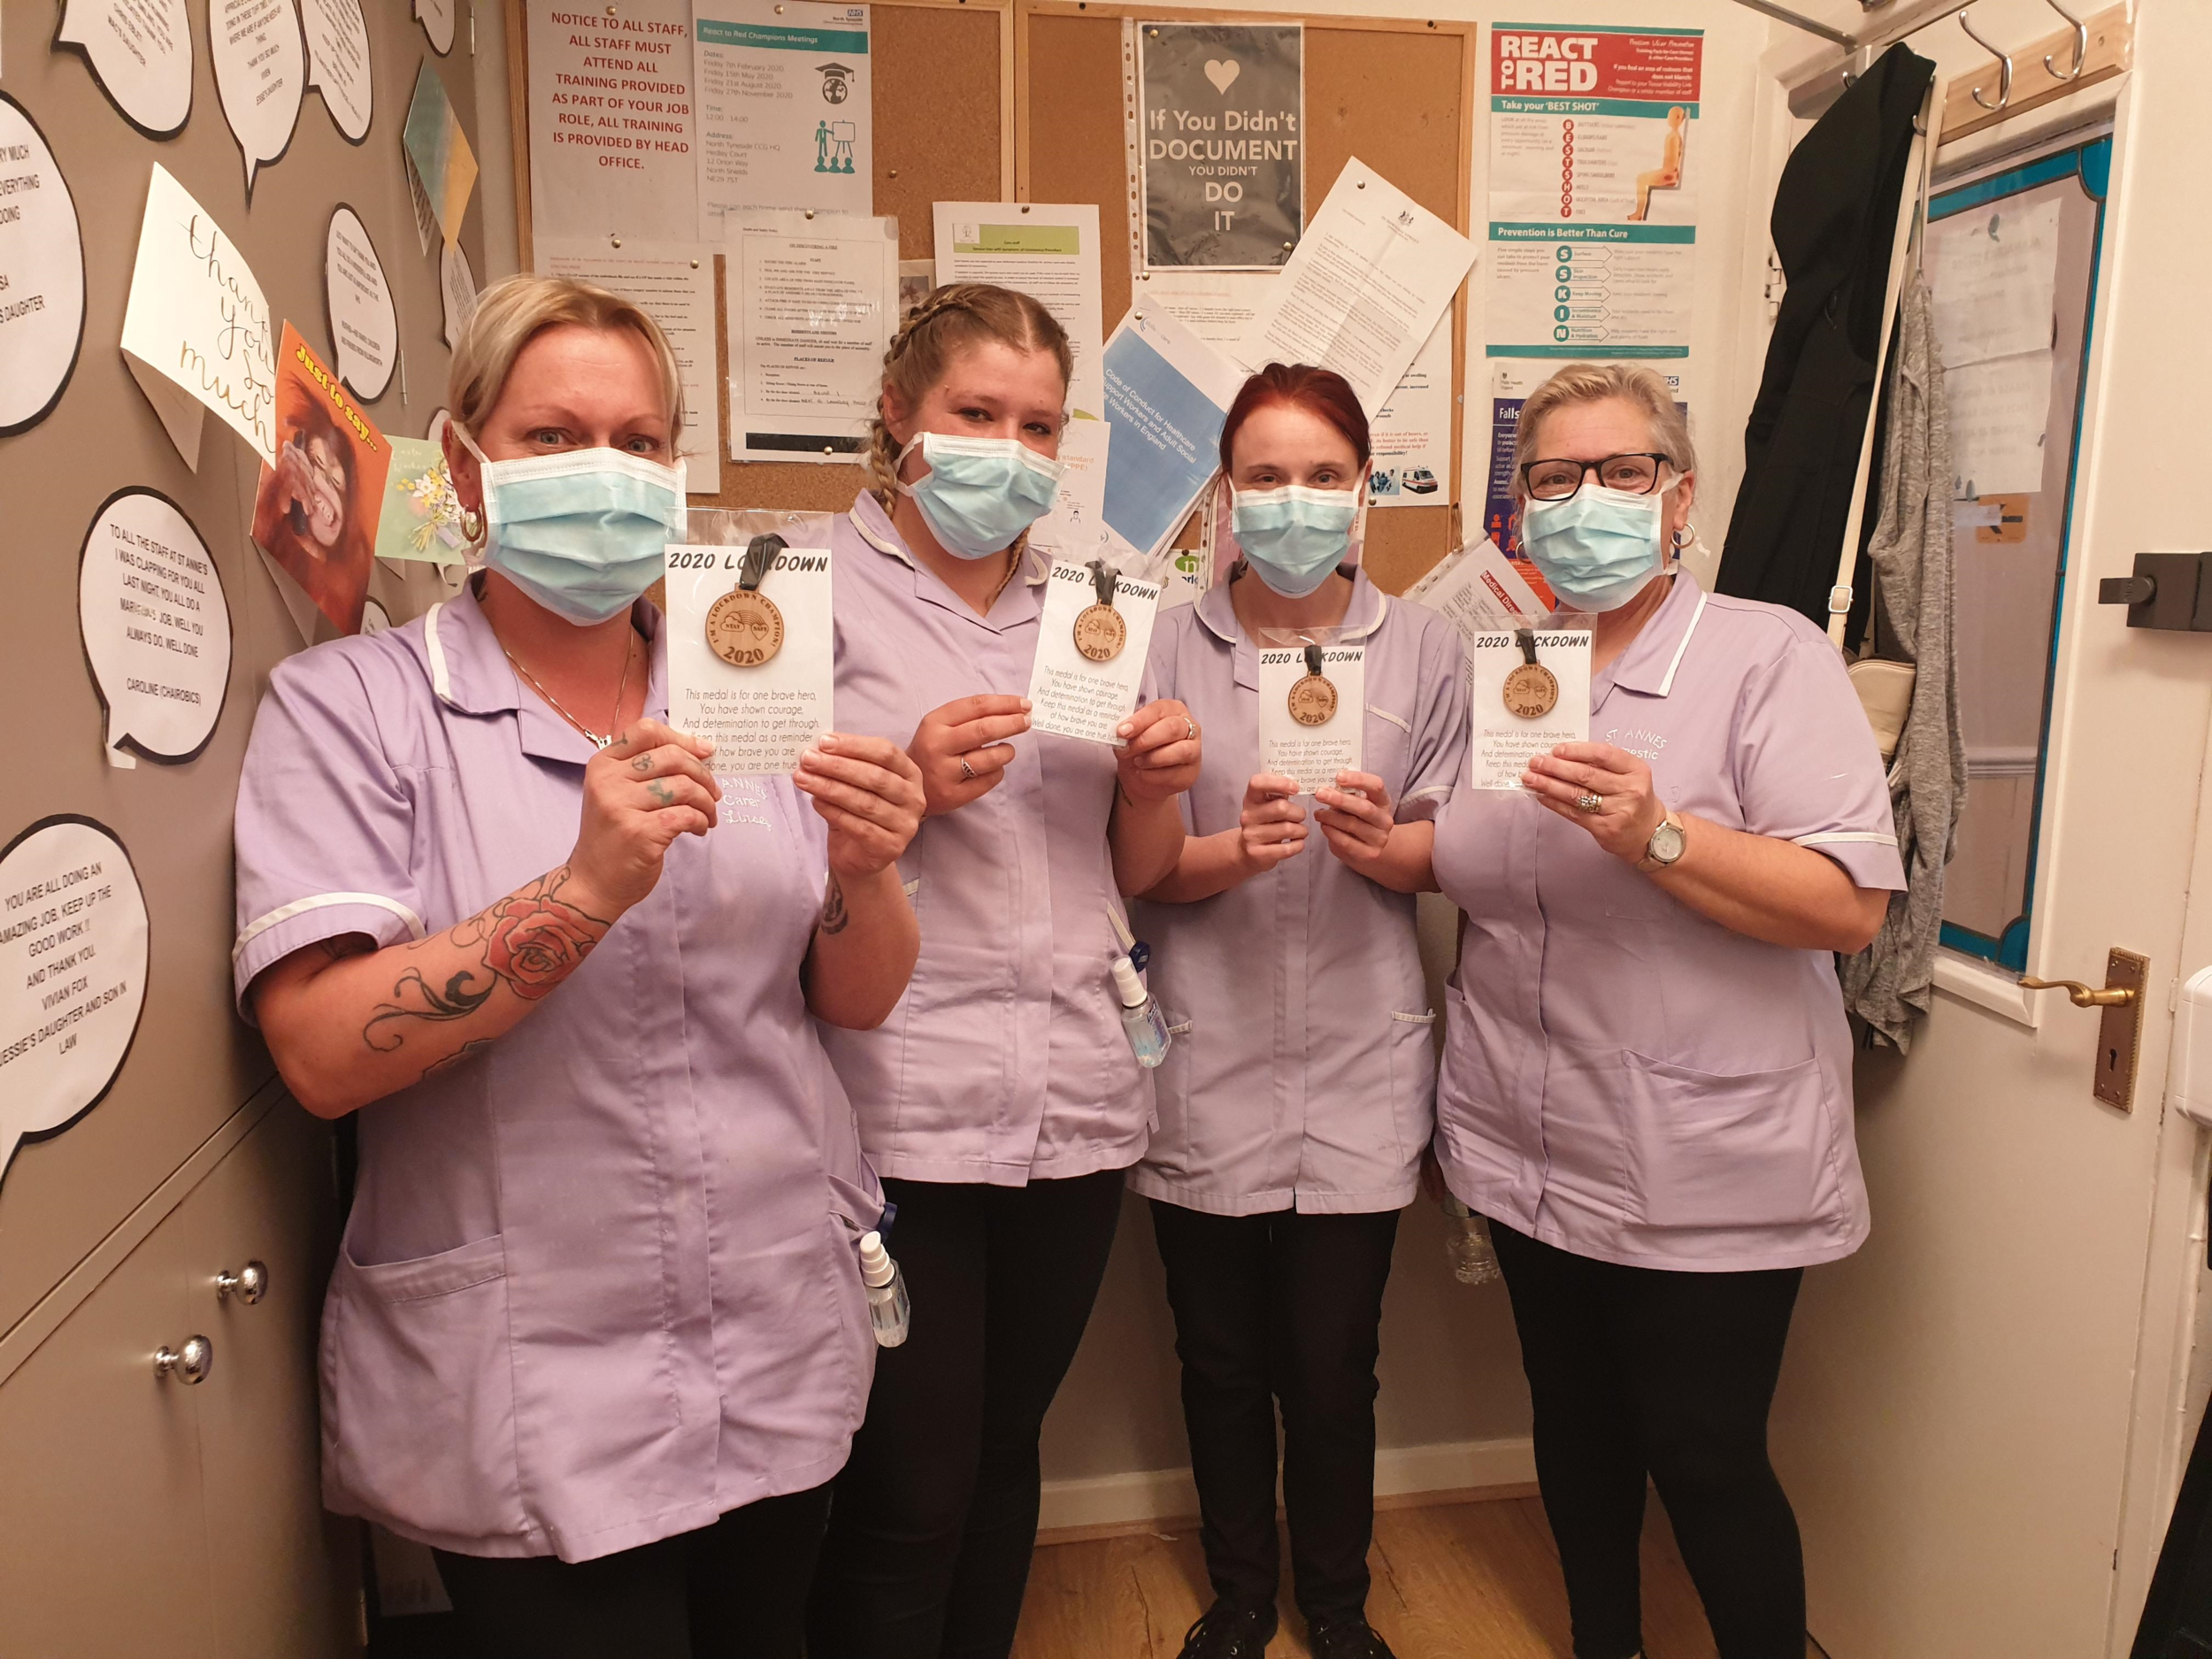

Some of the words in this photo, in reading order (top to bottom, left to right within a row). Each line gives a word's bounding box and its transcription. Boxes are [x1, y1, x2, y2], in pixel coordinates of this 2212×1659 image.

[551, 12, 597, 27] NOTICE
[602, 18, 618, 29] TO
[623, 20, 643, 32] ALL
[648, 22, 687, 38] STAFF,
[703, 27, 723, 36] React
[749, 33, 786, 42] Champions
[787, 35, 818, 43] Meetings
[570, 35, 590, 47] ALL
[595, 37, 631, 50] STAFF
[635, 41, 671, 54] MUST
[1501, 35, 1598, 60] REACT
[584, 57, 633, 70] ATTEND
[637, 62, 657, 73] ALL
[1501, 59, 1514, 89] TO
[1517, 60, 1598, 91] RED
[557, 73, 618, 88] TRAINING
[622, 80, 685, 95] PROVIDED
[552, 93, 567, 104] AS
[572, 95, 603, 106] PART
[608, 98, 624, 109] OF
[628, 100, 663, 112] YOUR
[666, 103, 689, 114] JOB
[1502, 100, 1522, 109] Take
[1524, 103, 1544, 111] your
[559, 113, 594, 127] ROLE,
[598, 117, 618, 127] ALL
[623, 119, 682, 134] TRAINING
[1150, 109, 1166, 130] If
[1172, 111, 1216, 131] You
[1225, 110, 1295, 131] Didn't
[553, 132, 564, 142] IS
[568, 134, 632, 149] PROVIDED
[636, 139, 650, 150] BY
[656, 140, 688, 153] HEAD
[1150, 139, 1297, 160] DOCUMENT
[599, 156, 644, 169] OFFICE.
[1188, 166, 1214, 176] YOU
[1218, 166, 1258, 176] DIDN'T
[1206, 181, 1242, 202] DO
[1215, 211, 1235, 231] IT
[1498, 227, 1545, 237] Prevention
[1586, 229, 1607, 238] Than
[1609, 229, 1628, 238] Cure
[5, 296, 45, 321] DAUGHTER
[296, 343, 328, 390] Just
[329, 382, 344, 409] to
[180, 341, 275, 453] much
[1106, 369, 1122, 386] Code
[1129, 390, 1156, 415] Conduct
[1154, 412, 1164, 422] for
[1164, 420, 1195, 451] Healthcare
[1110, 397, 1134, 423] Workers
[1141, 426, 1167, 450] England
[1124, 397, 1148, 422] Workers
[1148, 421, 1162, 434] and
[1161, 431, 1178, 448] Adult
[1177, 444, 1197, 464] Social
[111, 524, 120, 539] TO
[122, 529, 135, 545] ALL
[136, 534, 150, 550] THE
[150, 541, 169, 558] STAFF
[170, 550, 176, 562] AT
[178, 553, 185, 565] ST
[115, 548, 118, 560] I
[119, 549, 134, 566] WAS
[136, 557, 166, 579] CLAPPING
[168, 570, 179, 584] FOR
[180, 575, 192, 589] YOU
[194, 580, 204, 594] ALL
[669, 553, 716, 569] 2020
[1052, 566, 1085, 583] 2020
[1481, 572, 1504, 598] Medical
[712, 593, 758, 618] LOCKDOWN
[760, 598, 780, 648] CHAMPION!
[127, 626, 151, 644] ALWAYS
[165, 638, 182, 653] WELL
[183, 642, 198, 657] DONE
[1084, 644, 1110, 659] 2020
[1477, 637, 1509, 648] 2020
[723, 646, 764, 664] 2020
[1261, 653, 1291, 664] 2020
[127, 678, 158, 695] CAROLINE
[686, 688, 700, 700] This
[703, 689, 728, 700] medal
[731, 689, 736, 700] is
[739, 690, 749, 700] for
[753, 692, 769, 701] one
[772, 690, 795, 701] brave
[797, 690, 817, 701] hero,
[700, 703, 716, 714] You
[718, 704, 739, 714] have
[741, 703, 765, 714] shown
[1300, 712, 1325, 723] 2020
[1515, 703, 1544, 716] 2020
[1606, 729, 1617, 741] ST
[1624, 729, 1667, 749] ANNES
[723, 795, 760, 807] Carer
[4, 892, 24, 911] YOU
[26, 884, 43, 903] ARE
[44, 878, 61, 896] ALL
[62, 866, 88, 888] DOING
[90, 862, 103, 877] AN
[61, 897, 83, 918] KEEP
[85, 892, 96, 907] UP
[97, 885, 111, 902] THE
[28, 934, 55, 957] GOOD
[57, 921, 83, 944] WORK
[42, 985, 70, 1010] VIVIAN
[72, 975, 88, 995] FOX
[59, 1033, 77, 1055] LAW
